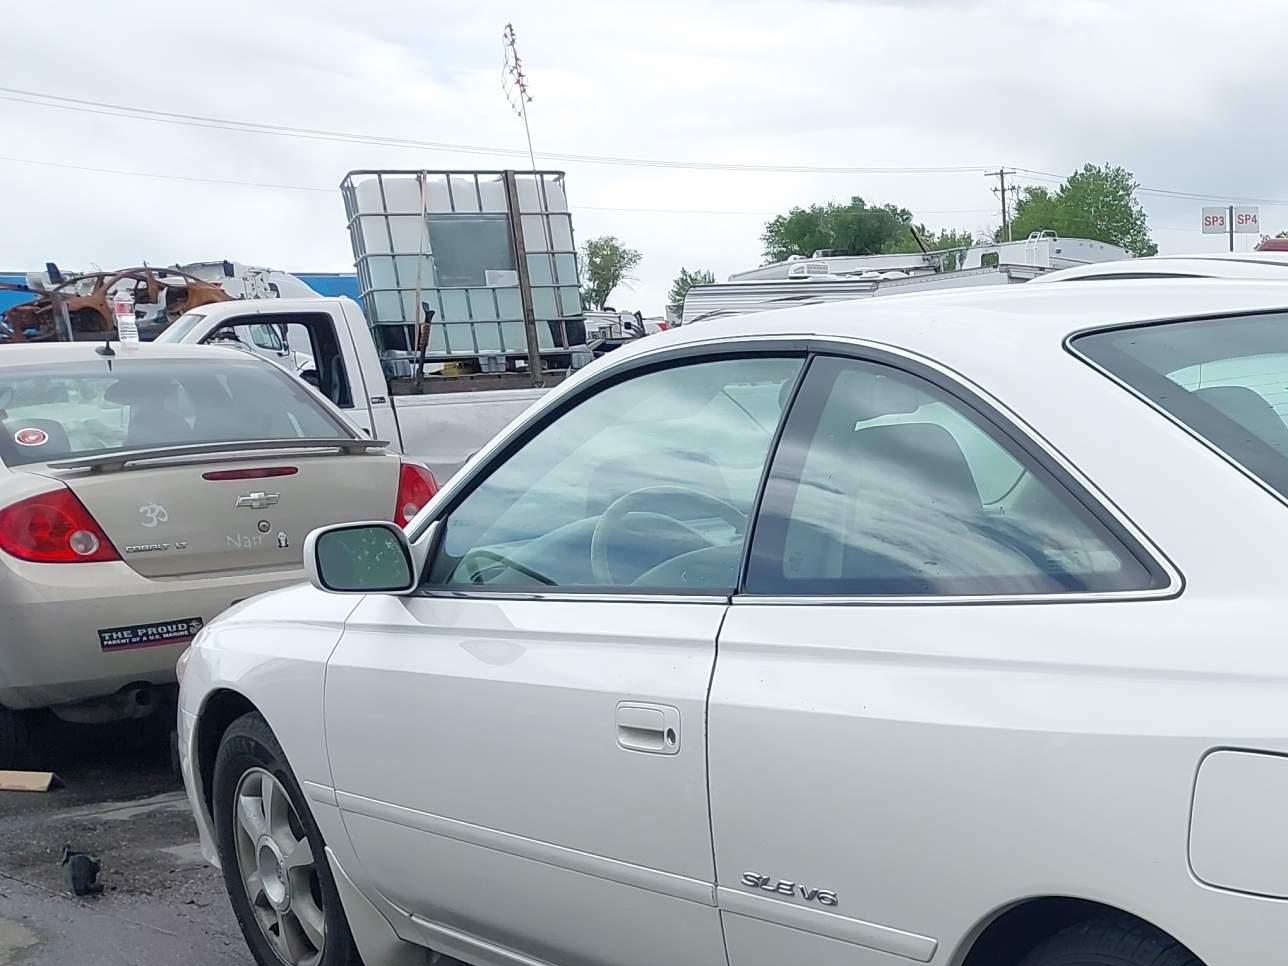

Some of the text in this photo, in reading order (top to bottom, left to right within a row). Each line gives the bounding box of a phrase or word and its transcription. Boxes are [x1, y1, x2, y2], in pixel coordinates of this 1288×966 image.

[1204, 215, 1225, 227] SP3
[1237, 213, 1258, 225] SP4
[101, 623, 188, 641] THE PROUD
[103, 638, 130, 646] PARENT
[162, 630, 189, 638] MARINE
[740, 871, 839, 906] SLE V6
